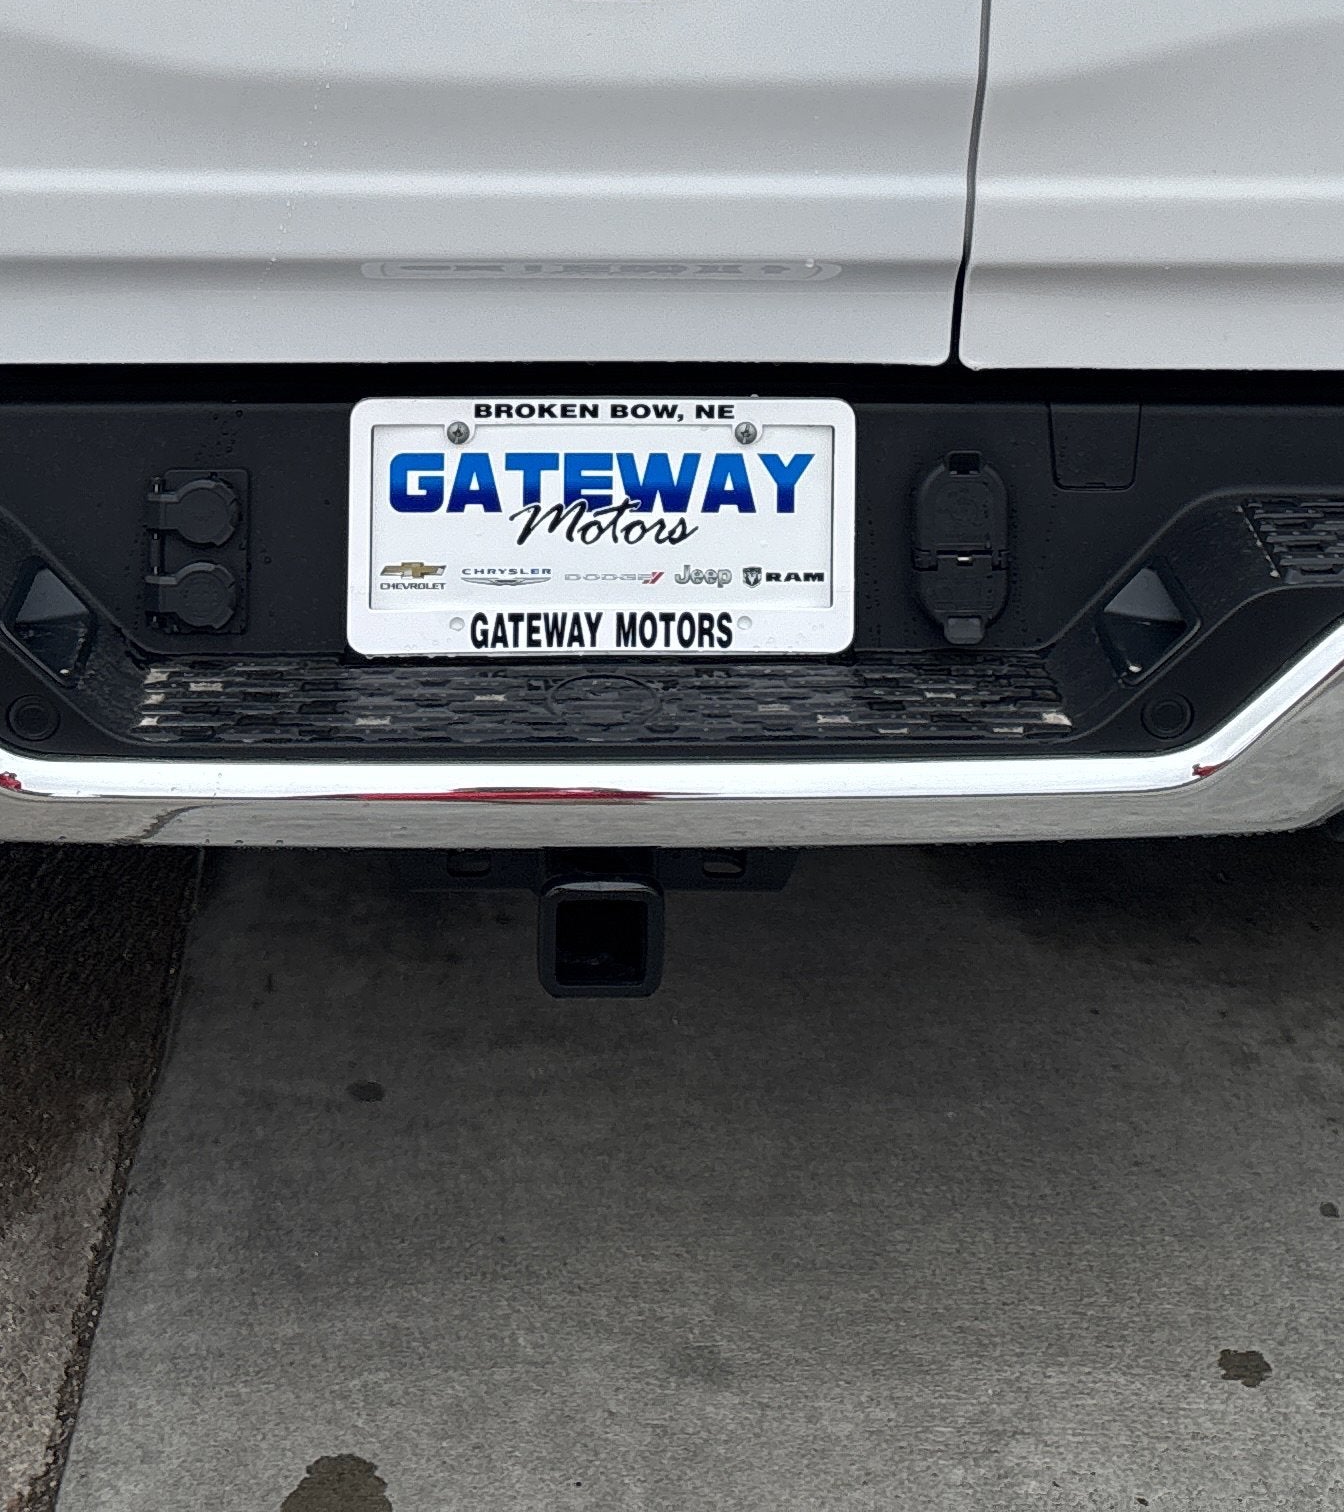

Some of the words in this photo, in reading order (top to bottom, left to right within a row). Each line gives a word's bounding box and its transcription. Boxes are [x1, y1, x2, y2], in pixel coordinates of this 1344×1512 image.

[474, 404, 599, 419] BROKEN
[610, 404, 684, 422] BOW,
[696, 404, 735, 419] NE
[389, 452, 816, 514] GATEWAY
[508, 498, 699, 545] Motors
[380, 582, 446, 590] CHEVROLET
[564, 573, 650, 581] DODGE
[674, 564, 733, 588] Jeep
[766, 572, 825, 582] RAM
[469, 613, 603, 649] GATEWAY
[616, 613, 733, 648] MOTORS
